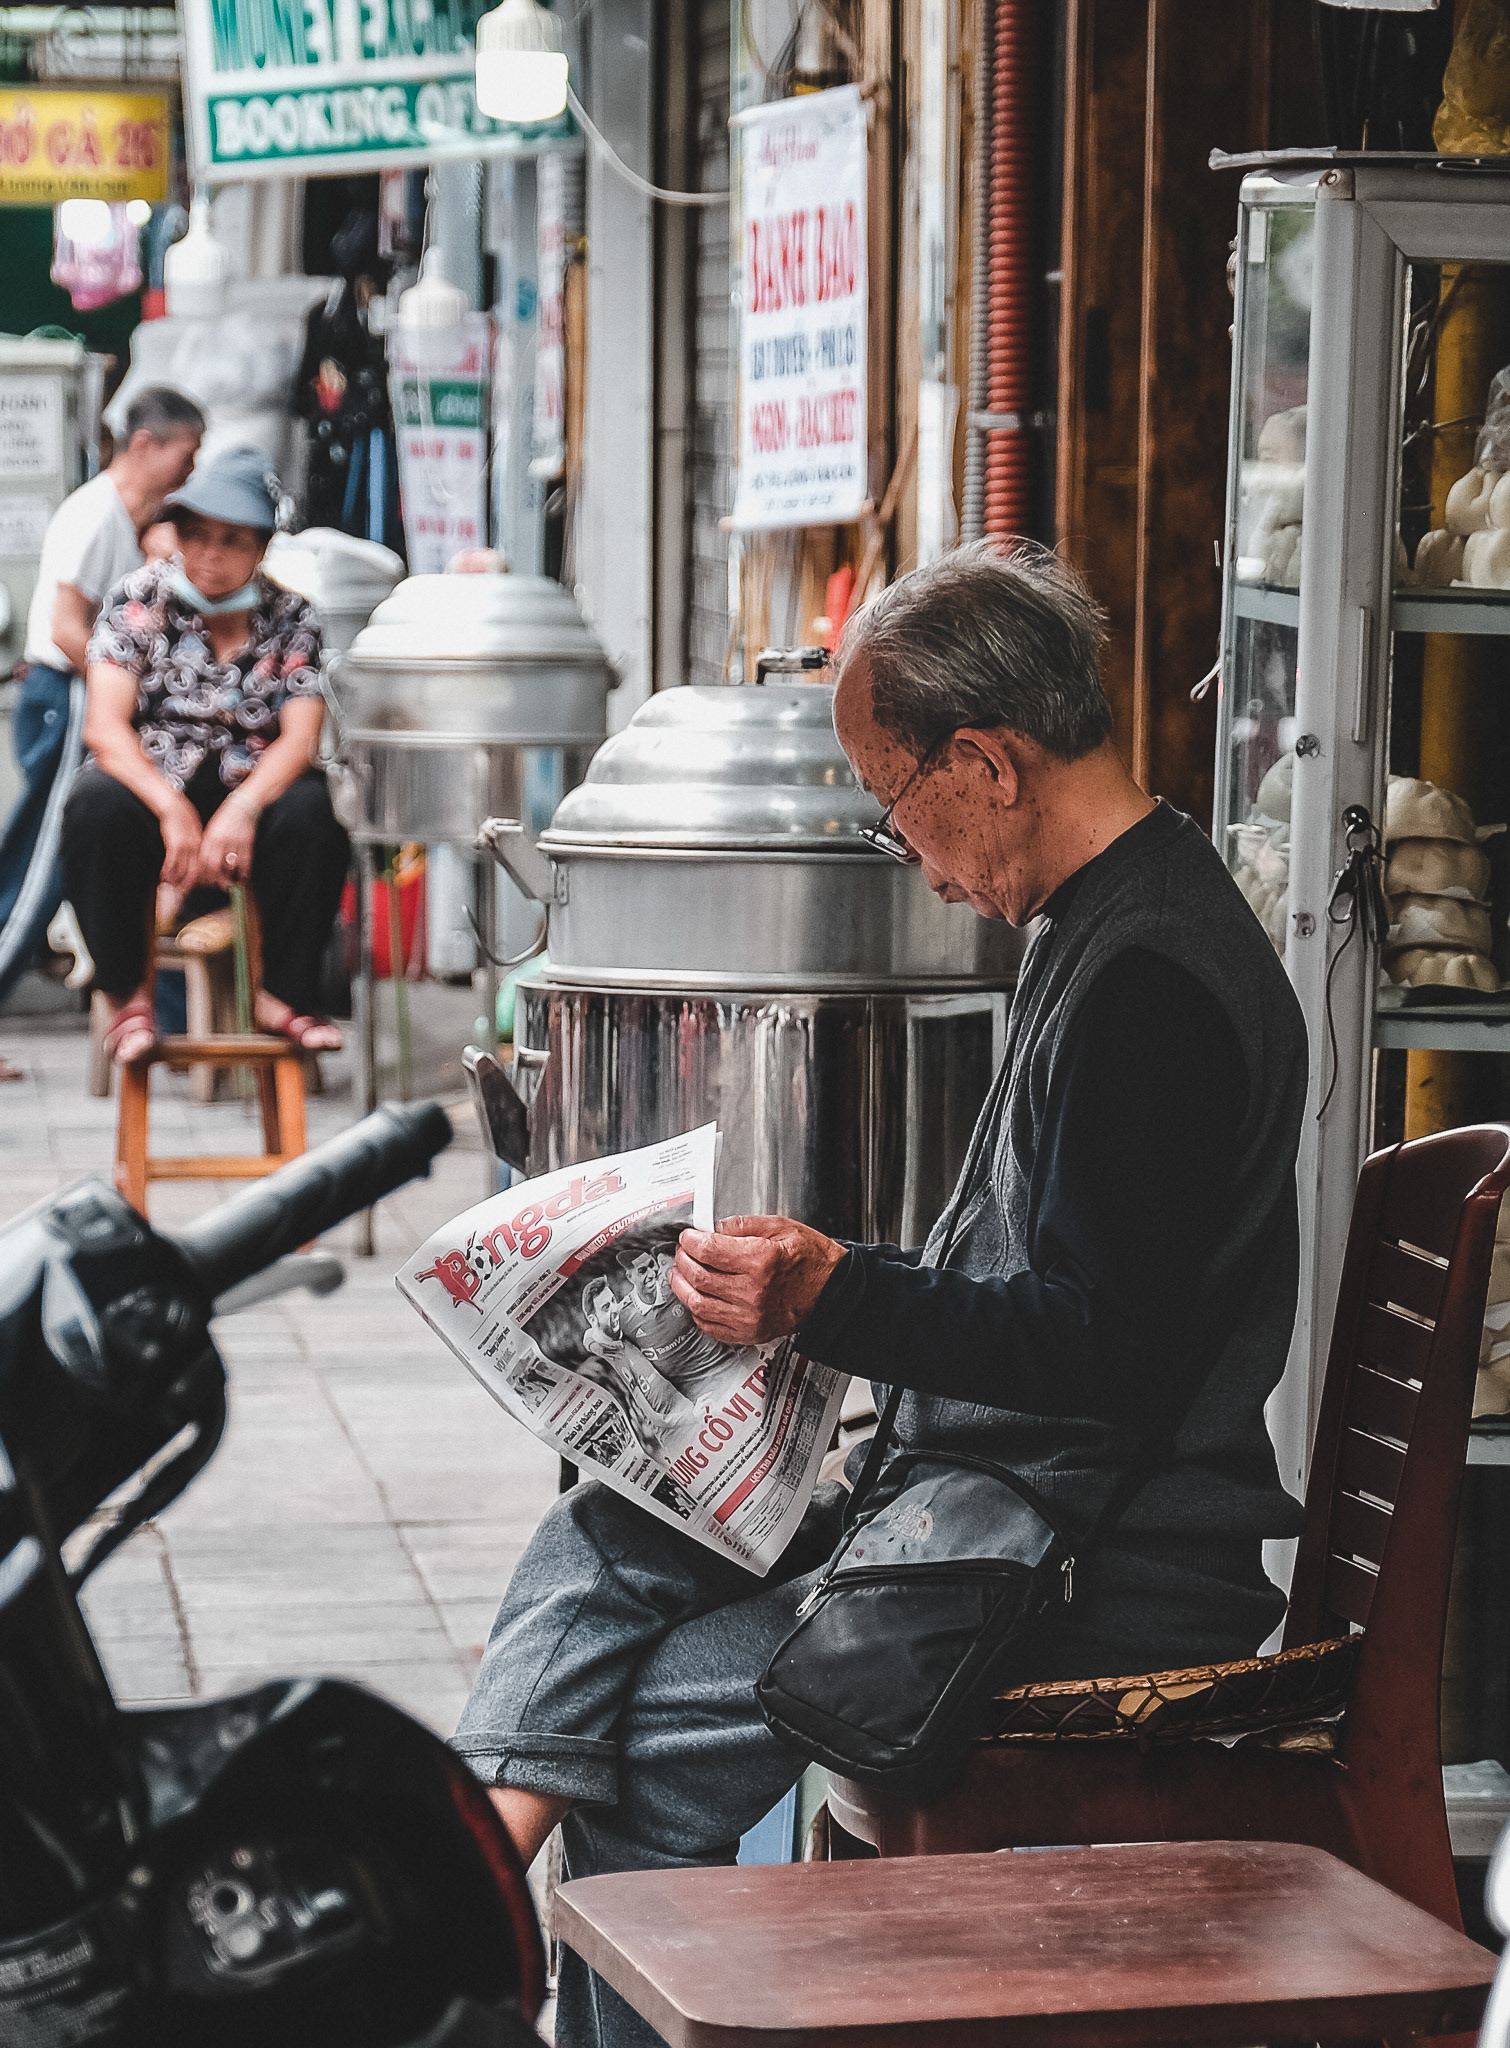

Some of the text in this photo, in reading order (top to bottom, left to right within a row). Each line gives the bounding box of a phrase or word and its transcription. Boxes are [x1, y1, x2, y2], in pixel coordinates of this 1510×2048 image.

[213, 87, 409, 156] BOOKING
[609, 1201, 668, 1236] SOUTHAMPTON
[699, 1406, 734, 1452] CỐ
[722, 1393, 762, 1423] VỊ
